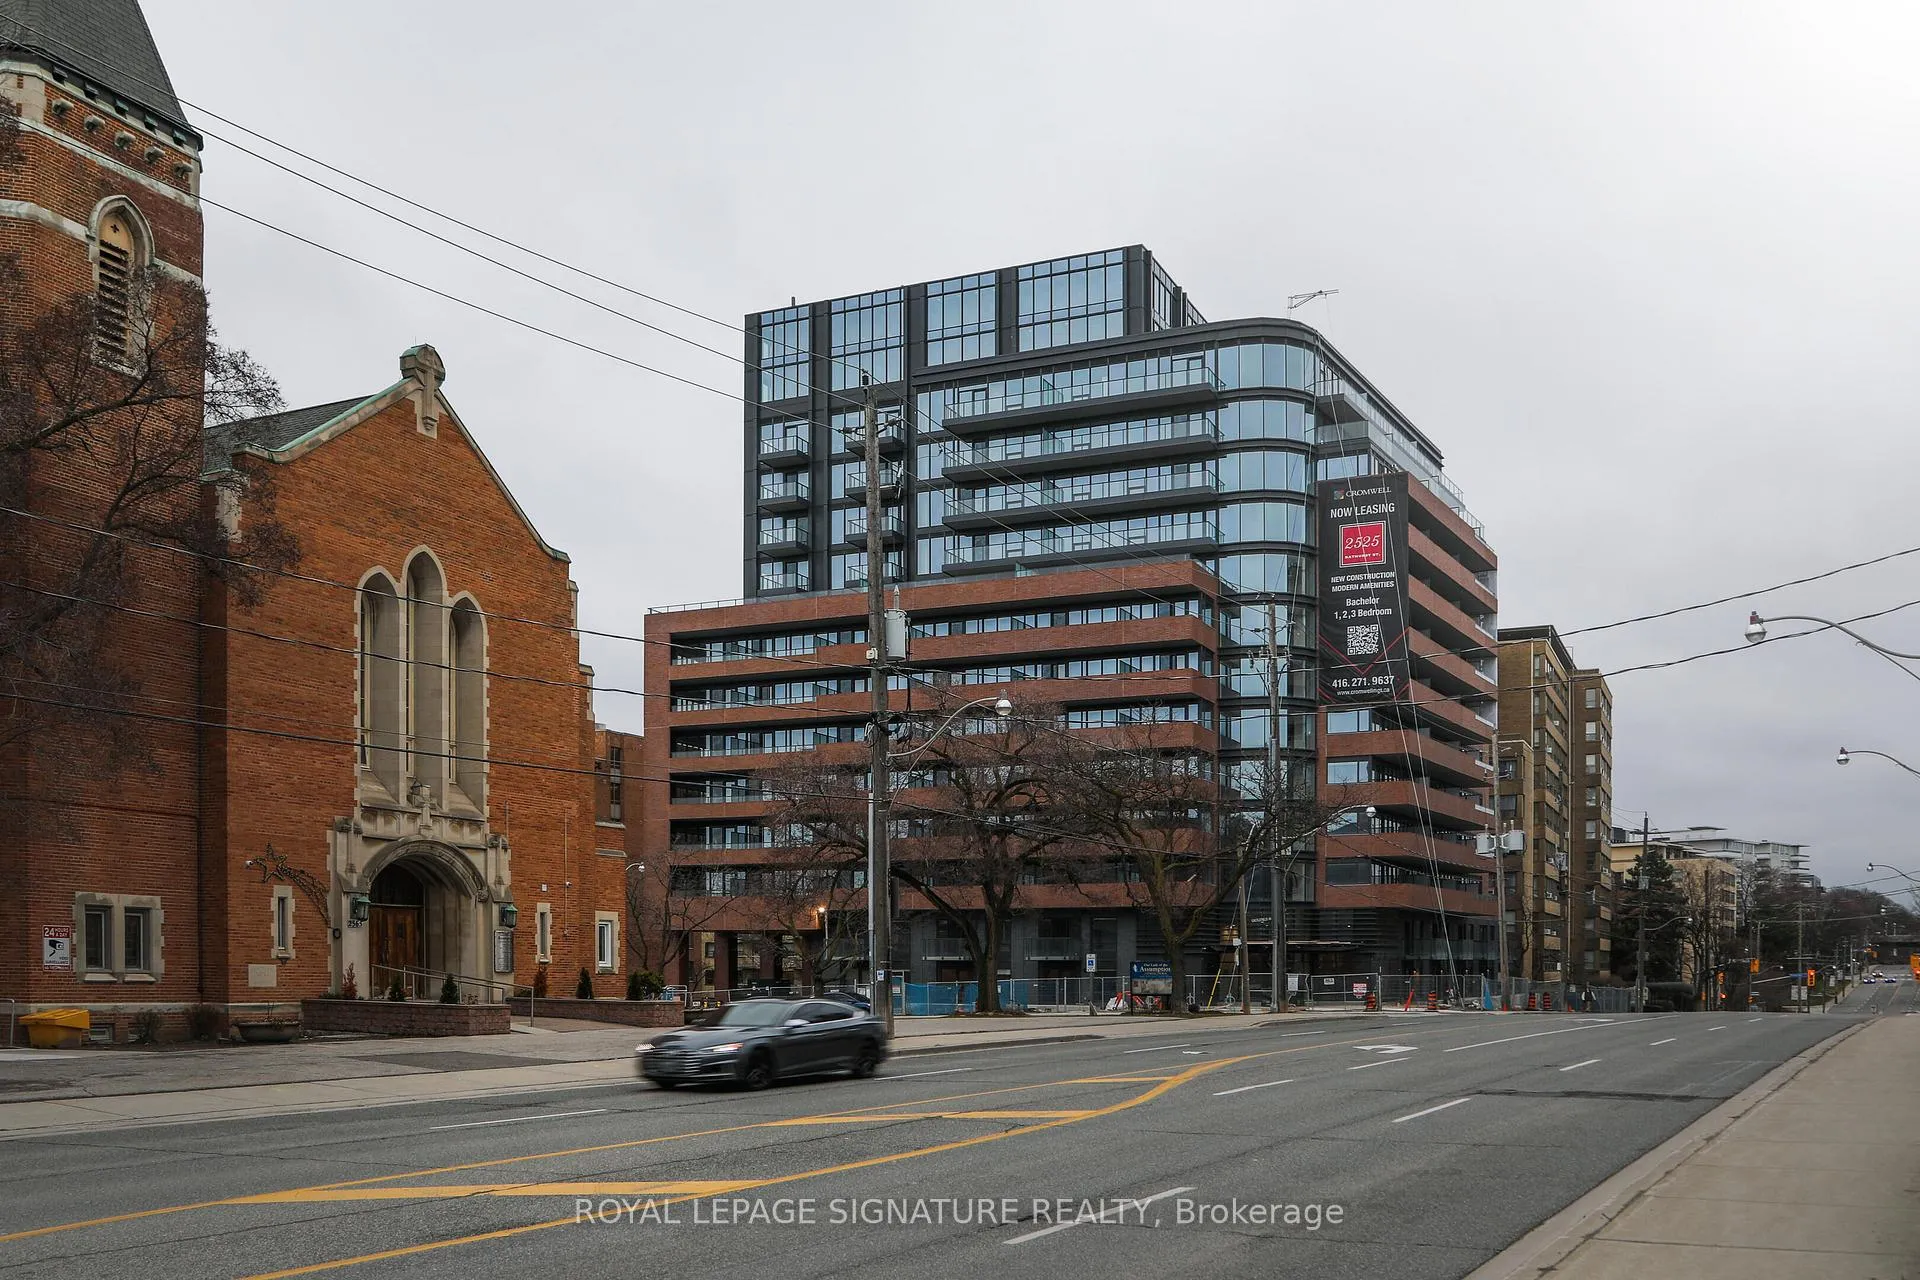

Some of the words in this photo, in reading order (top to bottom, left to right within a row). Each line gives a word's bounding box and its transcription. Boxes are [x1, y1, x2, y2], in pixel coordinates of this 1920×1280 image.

[1345, 486, 1392, 498] CROMWELL
[1330, 506, 1353, 519] NOW
[1355, 502, 1395, 516] LEASING
[1344, 534, 1380, 550] 2525
[1331, 575, 1346, 583] NEW
[1346, 571, 1395, 582] CONSTRUCTION
[1331, 583, 1359, 593] MODERN
[1359, 580, 1395, 590] AMENITIES
[1345, 596, 1380, 607] Bachelor
[1357, 608, 1392, 618] Bedroom
[44, 927, 55, 937] 24
